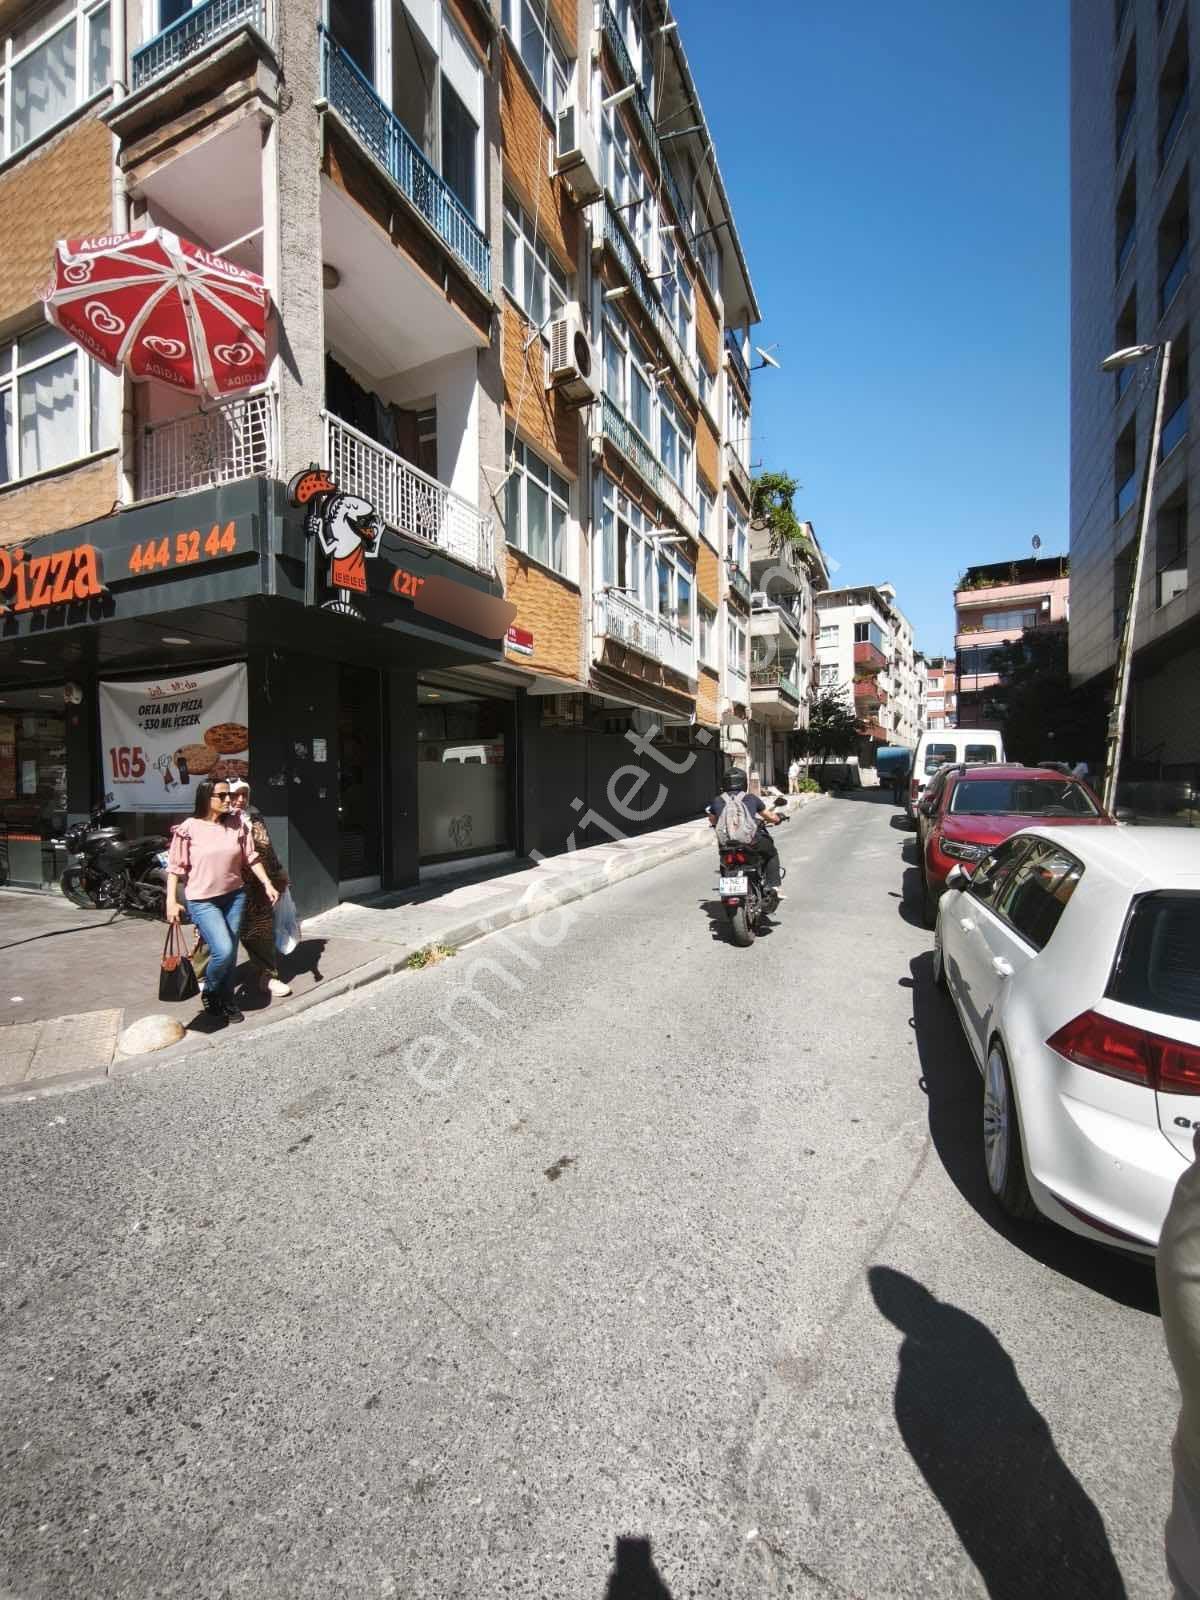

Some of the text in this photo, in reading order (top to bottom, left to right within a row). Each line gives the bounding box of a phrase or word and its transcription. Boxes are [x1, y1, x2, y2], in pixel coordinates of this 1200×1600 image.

[79, 233, 131, 250] ALGIDA
[193, 249, 248, 279] ALGIDA
[129, 521, 236, 574] 444 52 44
[138, 703, 161, 716] ORTA
[163, 702, 179, 714] BOY
[143, 718, 160, 730] 330
[161, 717, 173, 728] ML
[110, 746, 146, 778] 165
